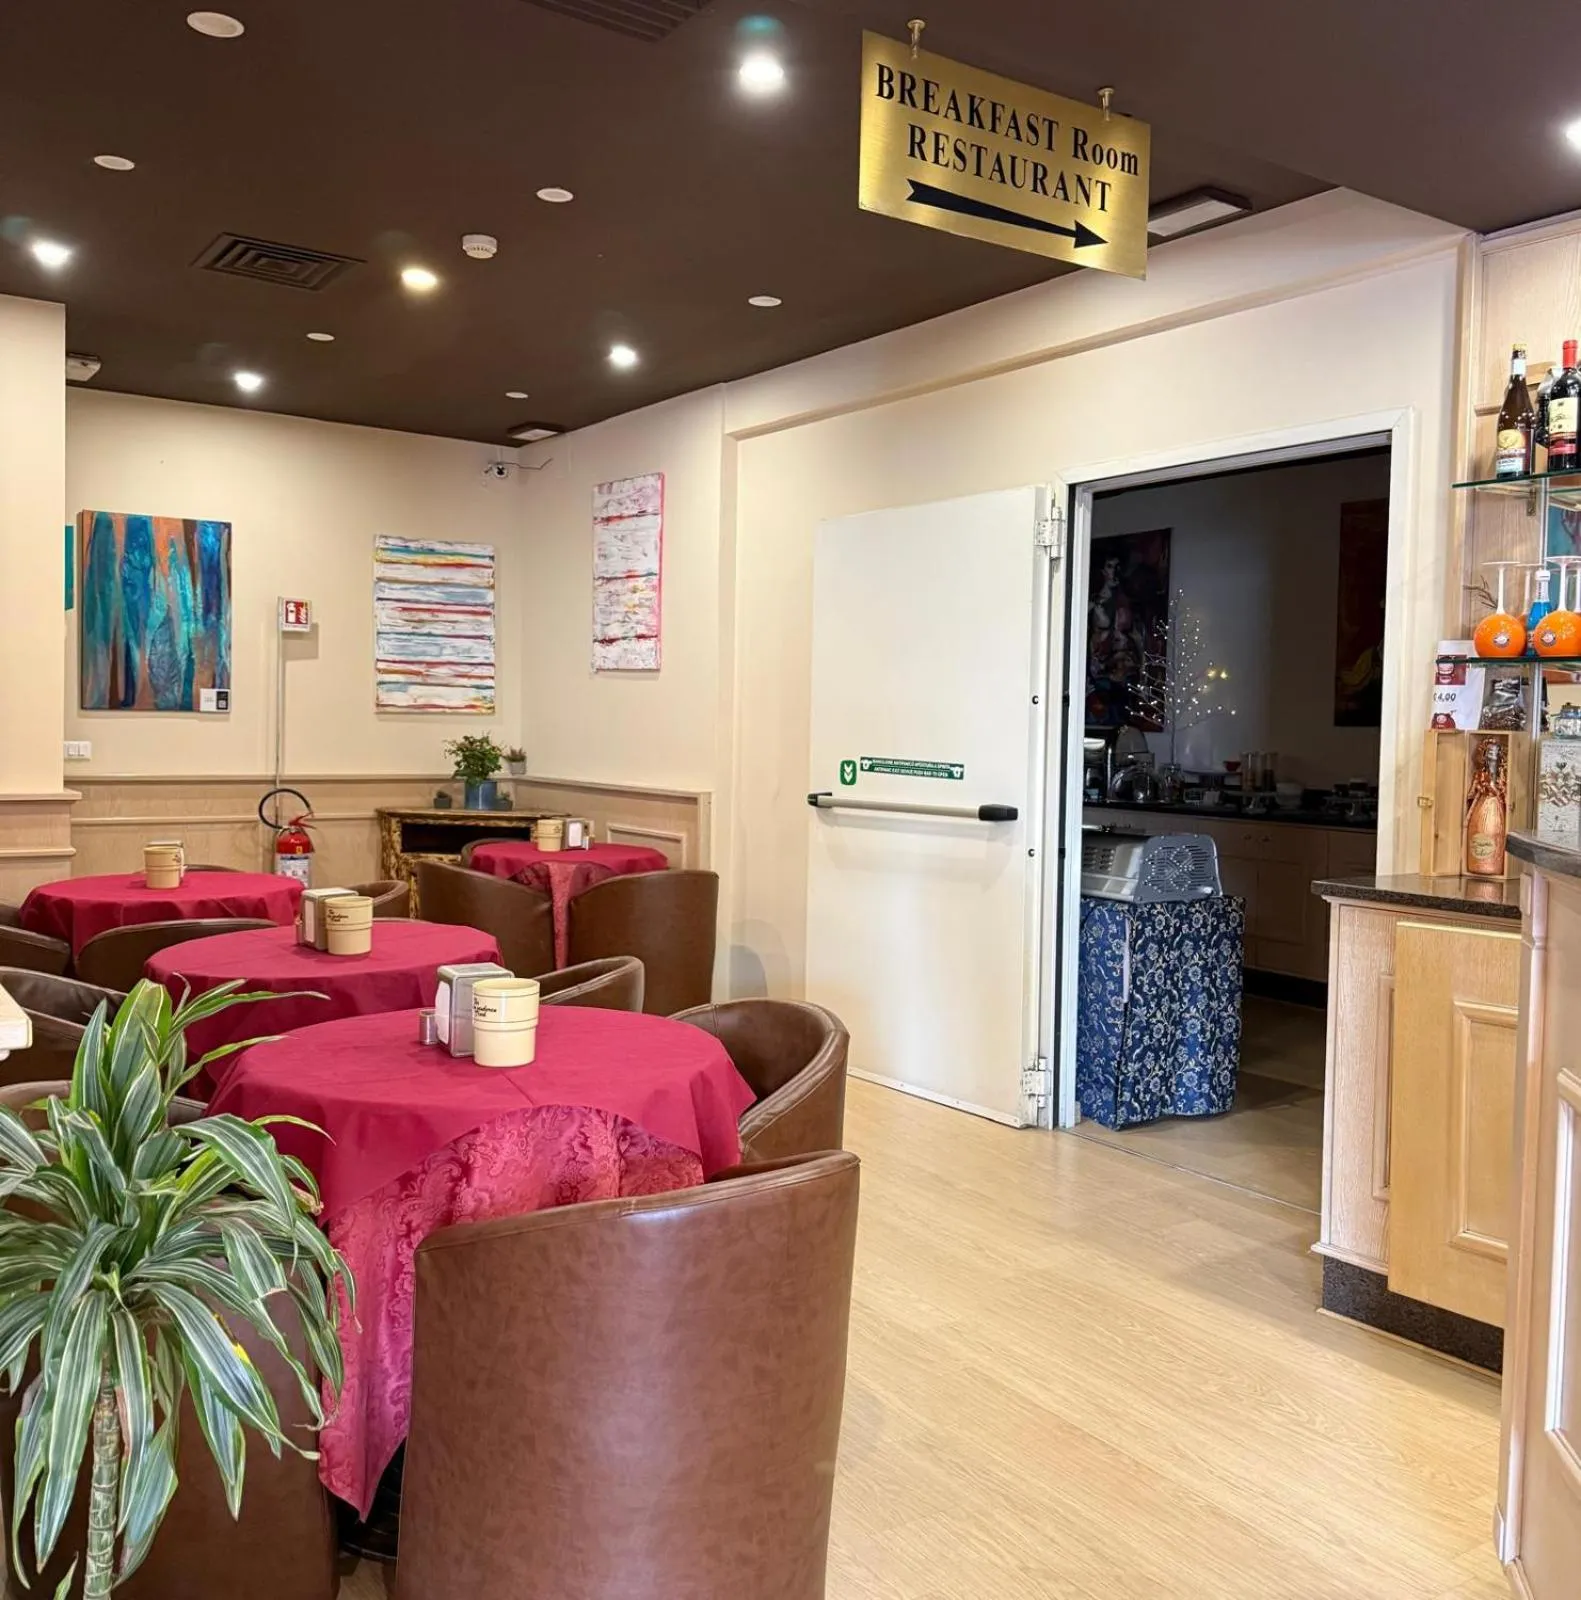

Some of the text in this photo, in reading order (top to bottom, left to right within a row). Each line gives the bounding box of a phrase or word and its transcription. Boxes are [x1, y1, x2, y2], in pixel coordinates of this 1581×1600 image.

[875, 62, 1140, 176] BREAKFAST Room
[907, 123, 1112, 212] RESTAURANT
